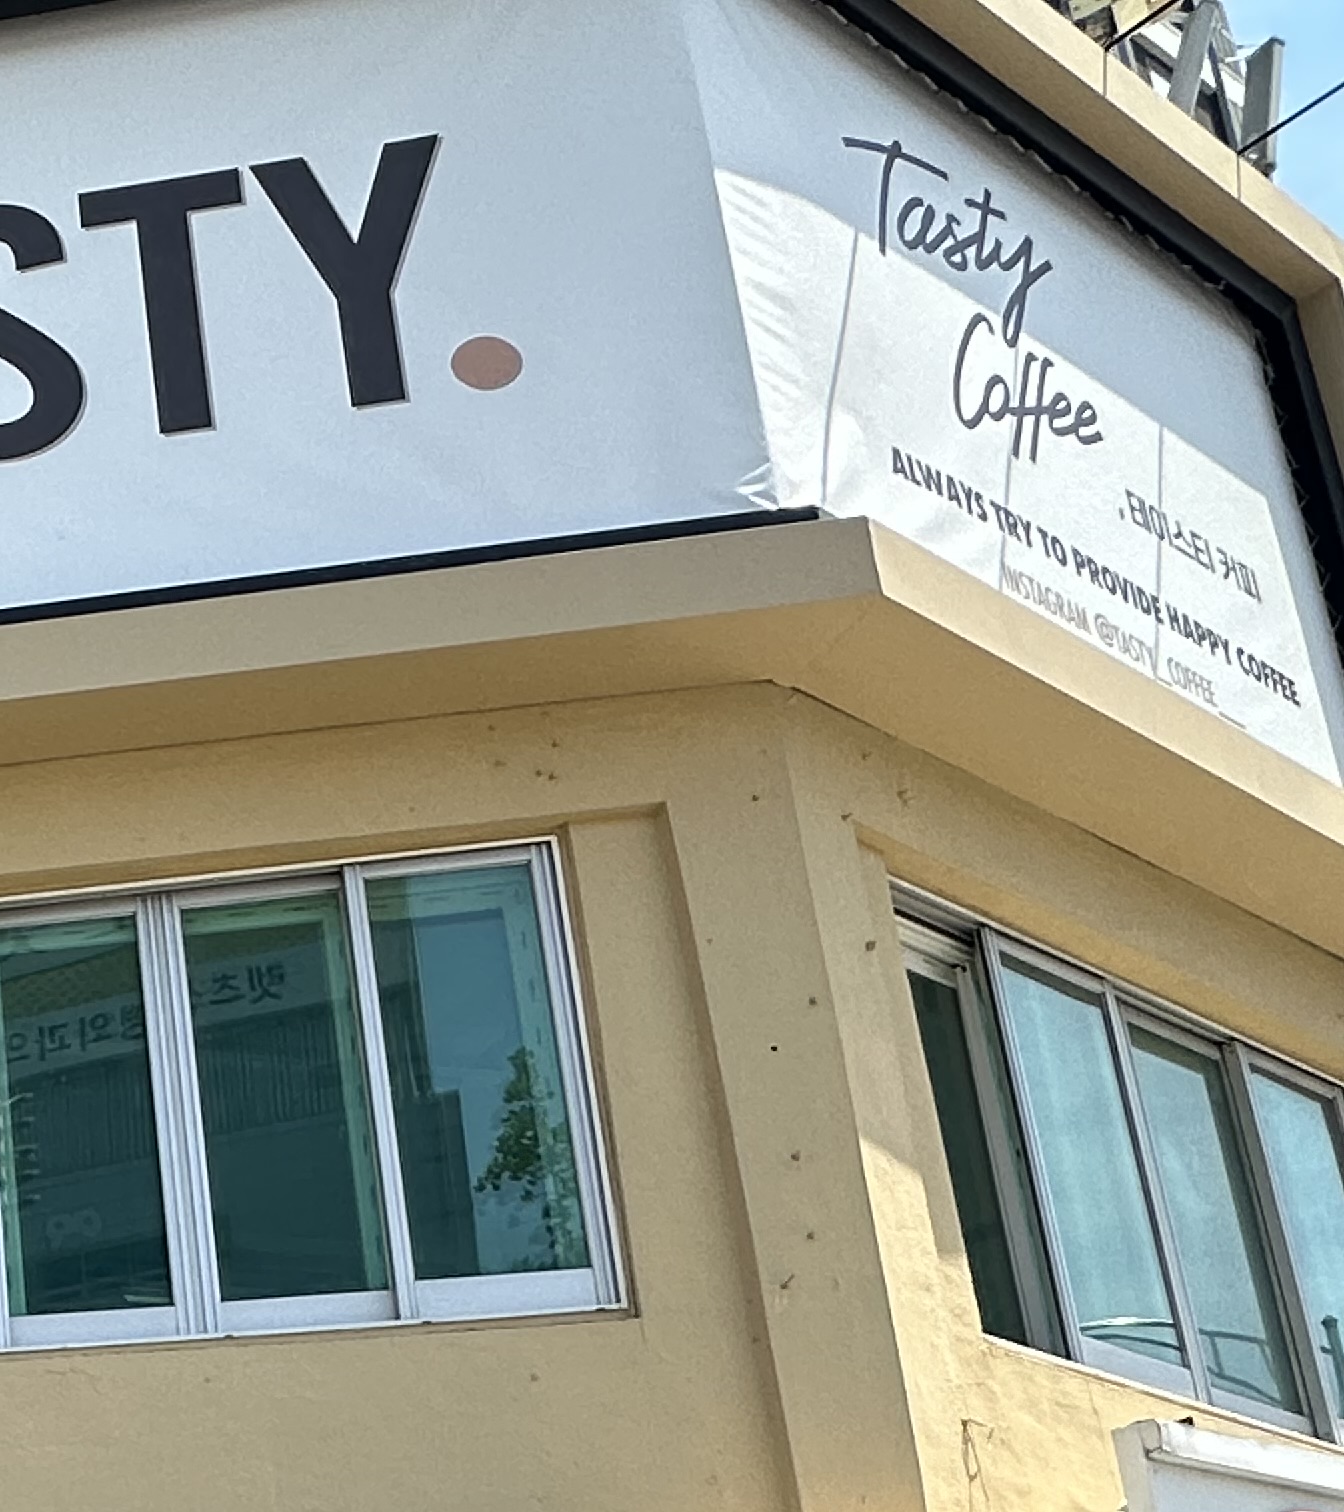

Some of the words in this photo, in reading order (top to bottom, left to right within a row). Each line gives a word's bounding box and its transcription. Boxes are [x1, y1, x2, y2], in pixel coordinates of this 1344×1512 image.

[841, 135, 1054, 348] Tasty
[952, 312, 1103, 463] Coffee
[892, 447, 988, 522] ALWAYS
[989, 500, 1032, 548] TRY
[1037, 526, 1069, 567] TO
[1071, 546, 1164, 626] PROVIDE
[1165, 601, 1233, 665] HAPPY
[1237, 647, 1303, 708] COFFEE
[1002, 565, 1092, 636] INSTAGRAM
[1216, 546, 1262, 604] 커피
